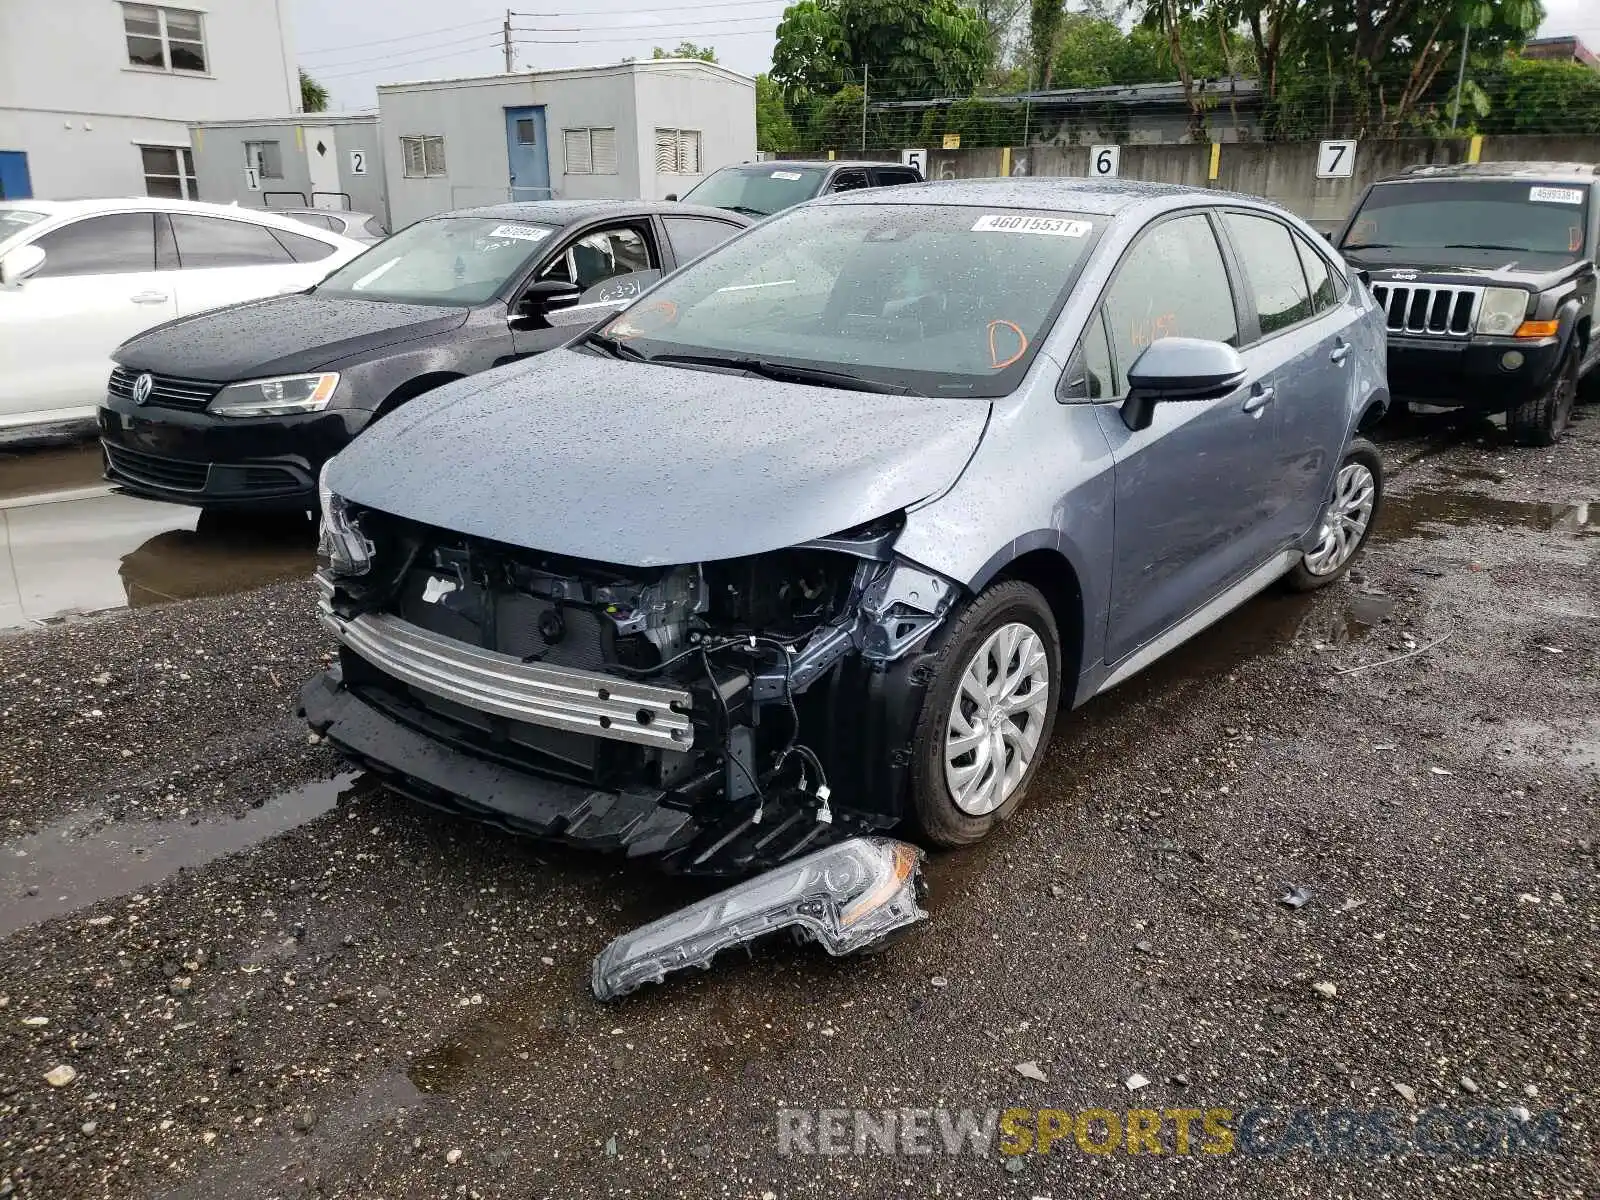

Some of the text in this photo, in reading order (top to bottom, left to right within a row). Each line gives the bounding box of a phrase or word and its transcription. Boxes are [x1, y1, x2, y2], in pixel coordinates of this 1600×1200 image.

[354, 153, 364, 172] 2
[909, 153, 920, 171] 5
[1096, 149, 1112, 174] 6
[1328, 145, 1347, 173] 7
[249, 170, 257, 188] 1
[1391, 270, 1417, 281] Jeep
[986, 319, 1028, 369] D
